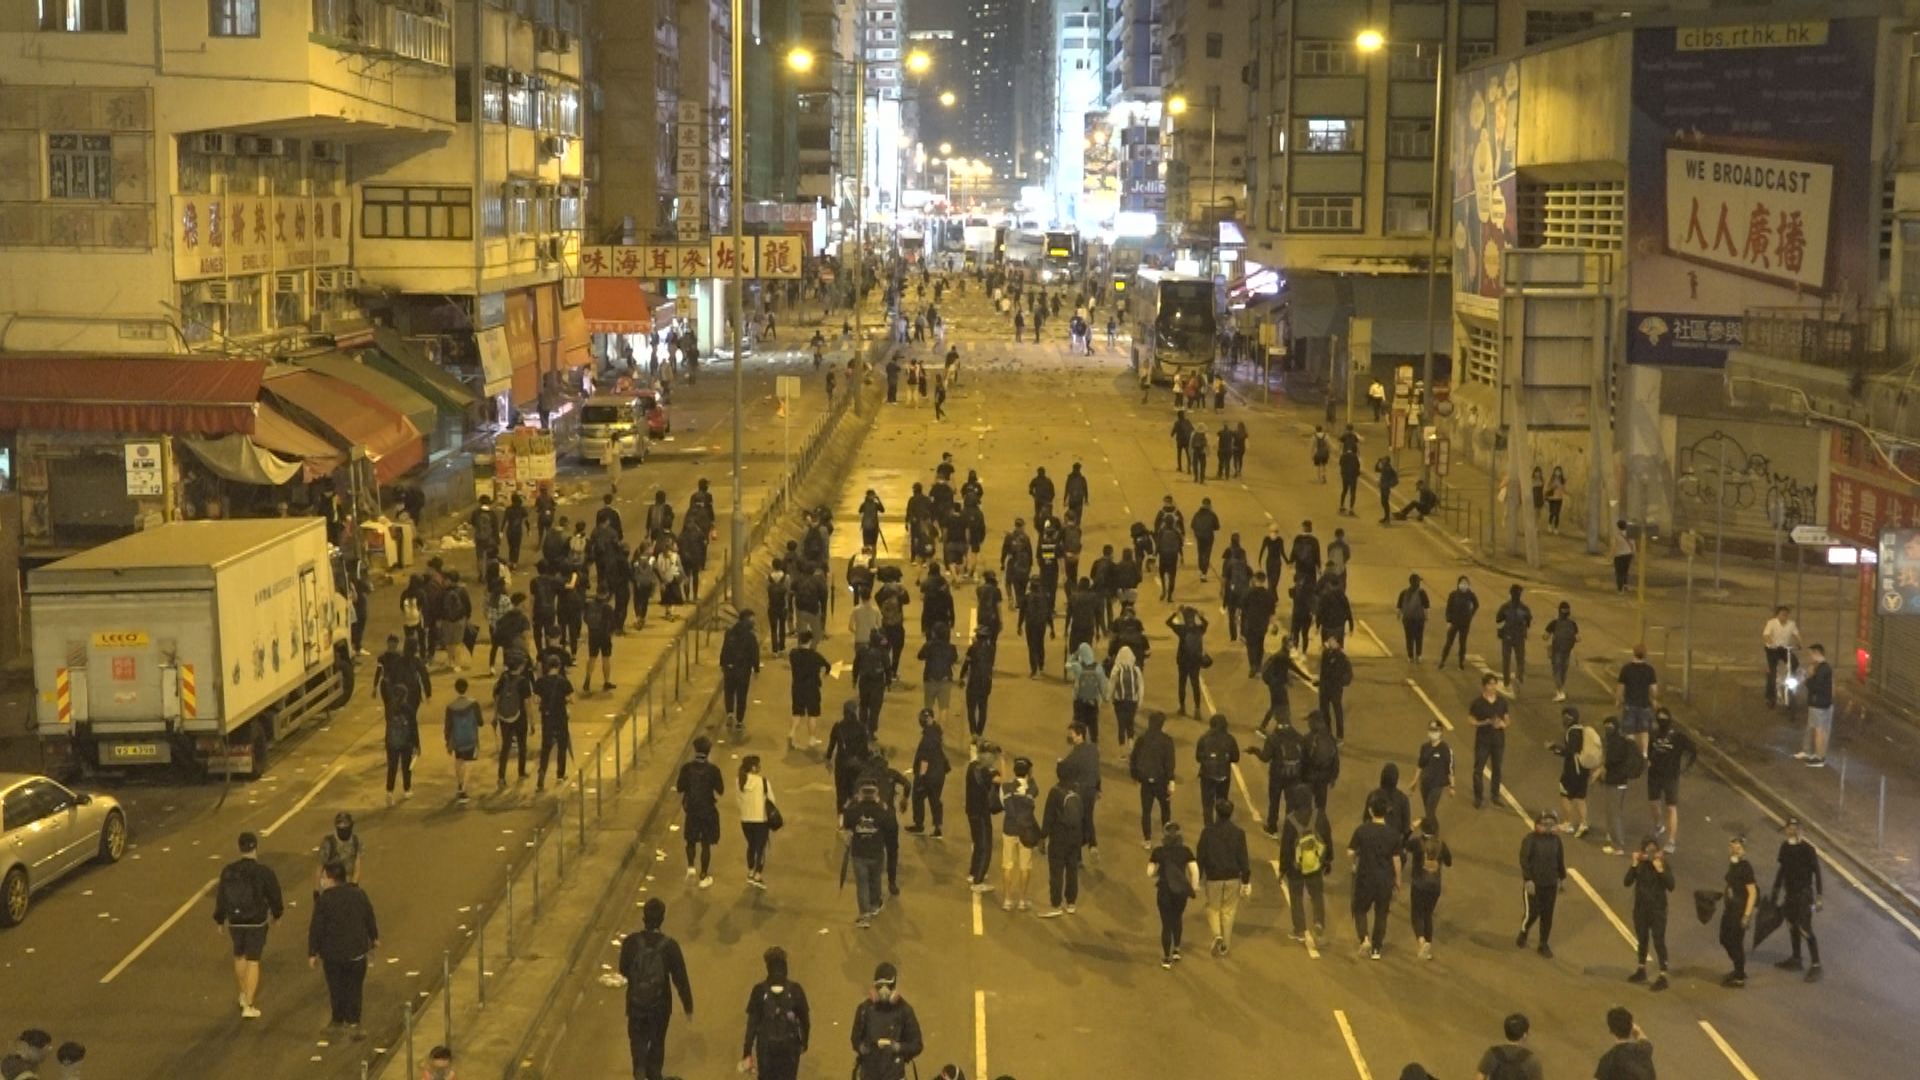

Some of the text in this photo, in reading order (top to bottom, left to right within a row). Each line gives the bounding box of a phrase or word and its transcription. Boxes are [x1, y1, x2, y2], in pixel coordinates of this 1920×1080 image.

[1684, 23, 1810, 48] cibs.rthk.hk
[1686, 159, 1811, 194] WE BROADCAST
[1685, 196, 1807, 275] 人人廣播
